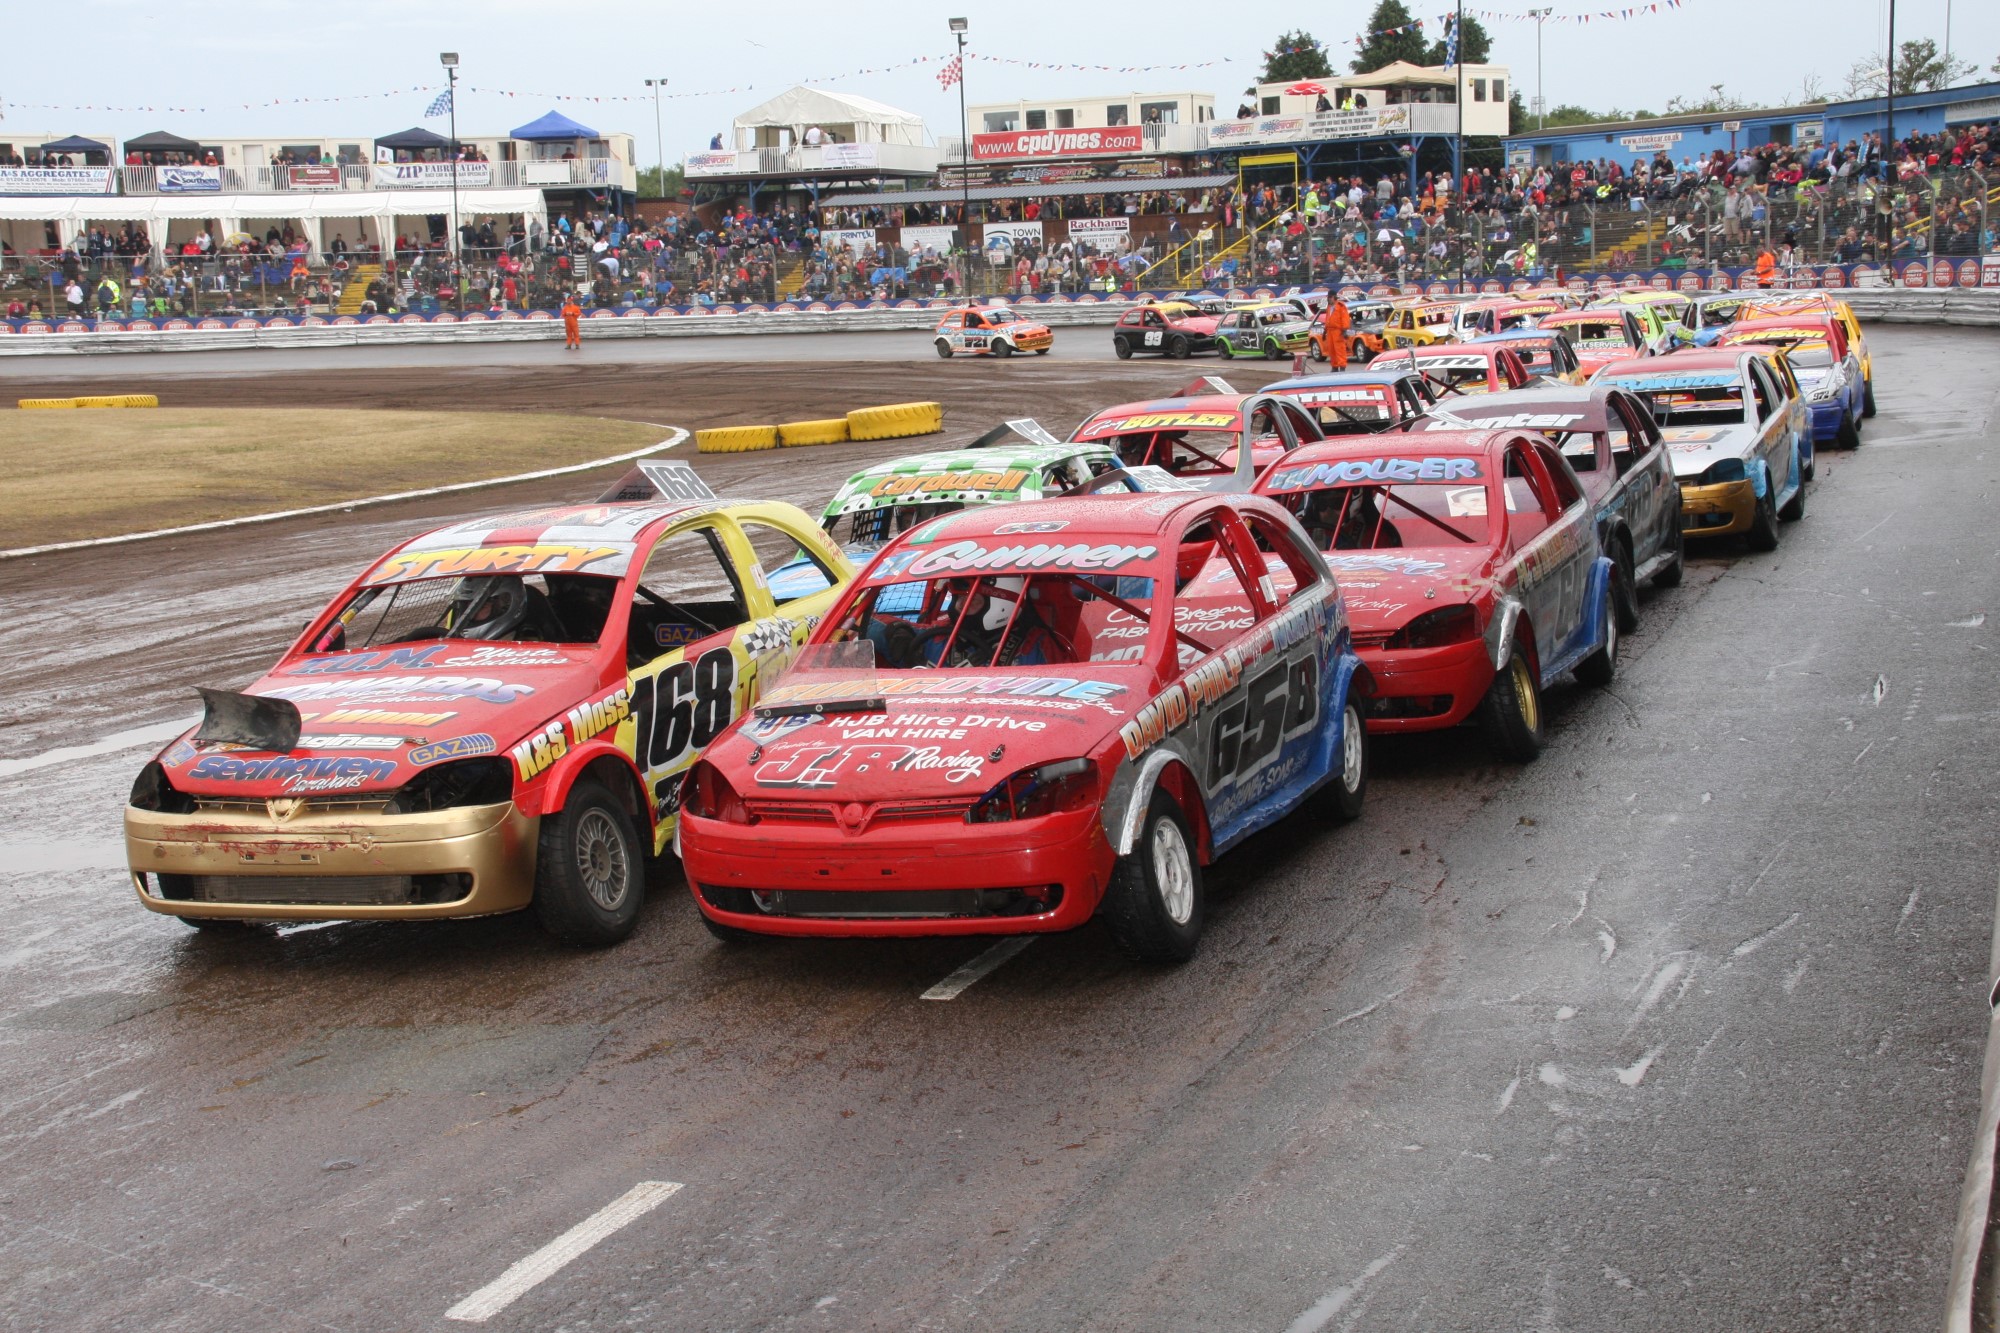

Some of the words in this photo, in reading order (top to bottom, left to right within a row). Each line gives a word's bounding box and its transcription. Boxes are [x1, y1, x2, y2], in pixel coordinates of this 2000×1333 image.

[978, 132, 1136, 154] www.cpdynes.com
[1622, 134, 1680, 145] www.stockcar.co.uk
[396, 166, 422, 178] ZIP
[425, 164, 488, 172] FABRIATION
[1013, 228, 1041, 236] TOWN
[1070, 220, 1128, 228] Rackhams
[1510, 306, 1557, 315] Buckley
[965, 337, 987, 348] 721
[1121, 413, 1238, 431] BUTLER
[1303, 458, 1484, 487] MOUZER
[644, 466, 717, 500] 168
[368, 546, 622, 584] STURTY
[910, 540, 1156, 576] Gunner
[1174, 606, 1252, 622] Brogan
[658, 628, 696, 644] GAZ
[435, 655, 568, 668] Solutions
[759, 676, 1127, 703] BURGOYNE
[630, 644, 738, 779] 168
[964, 697, 1081, 710] SPECIALISTS
[828, 714, 895, 728] HJB
[896, 714, 961, 728] Hire
[963, 714, 1048, 731] Drive
[1119, 684, 1188, 762] DAVID
[512, 721, 568, 782] K&S
[567, 688, 631, 744] Moss
[842, 728, 898, 740] VAN
[902, 728, 969, 740] HIRE
[412, 741, 462, 764] GAZ
[188, 756, 398, 780] Seahaven
[908, 747, 986, 783] Racing
[281, 772, 368, 794] Caravans
